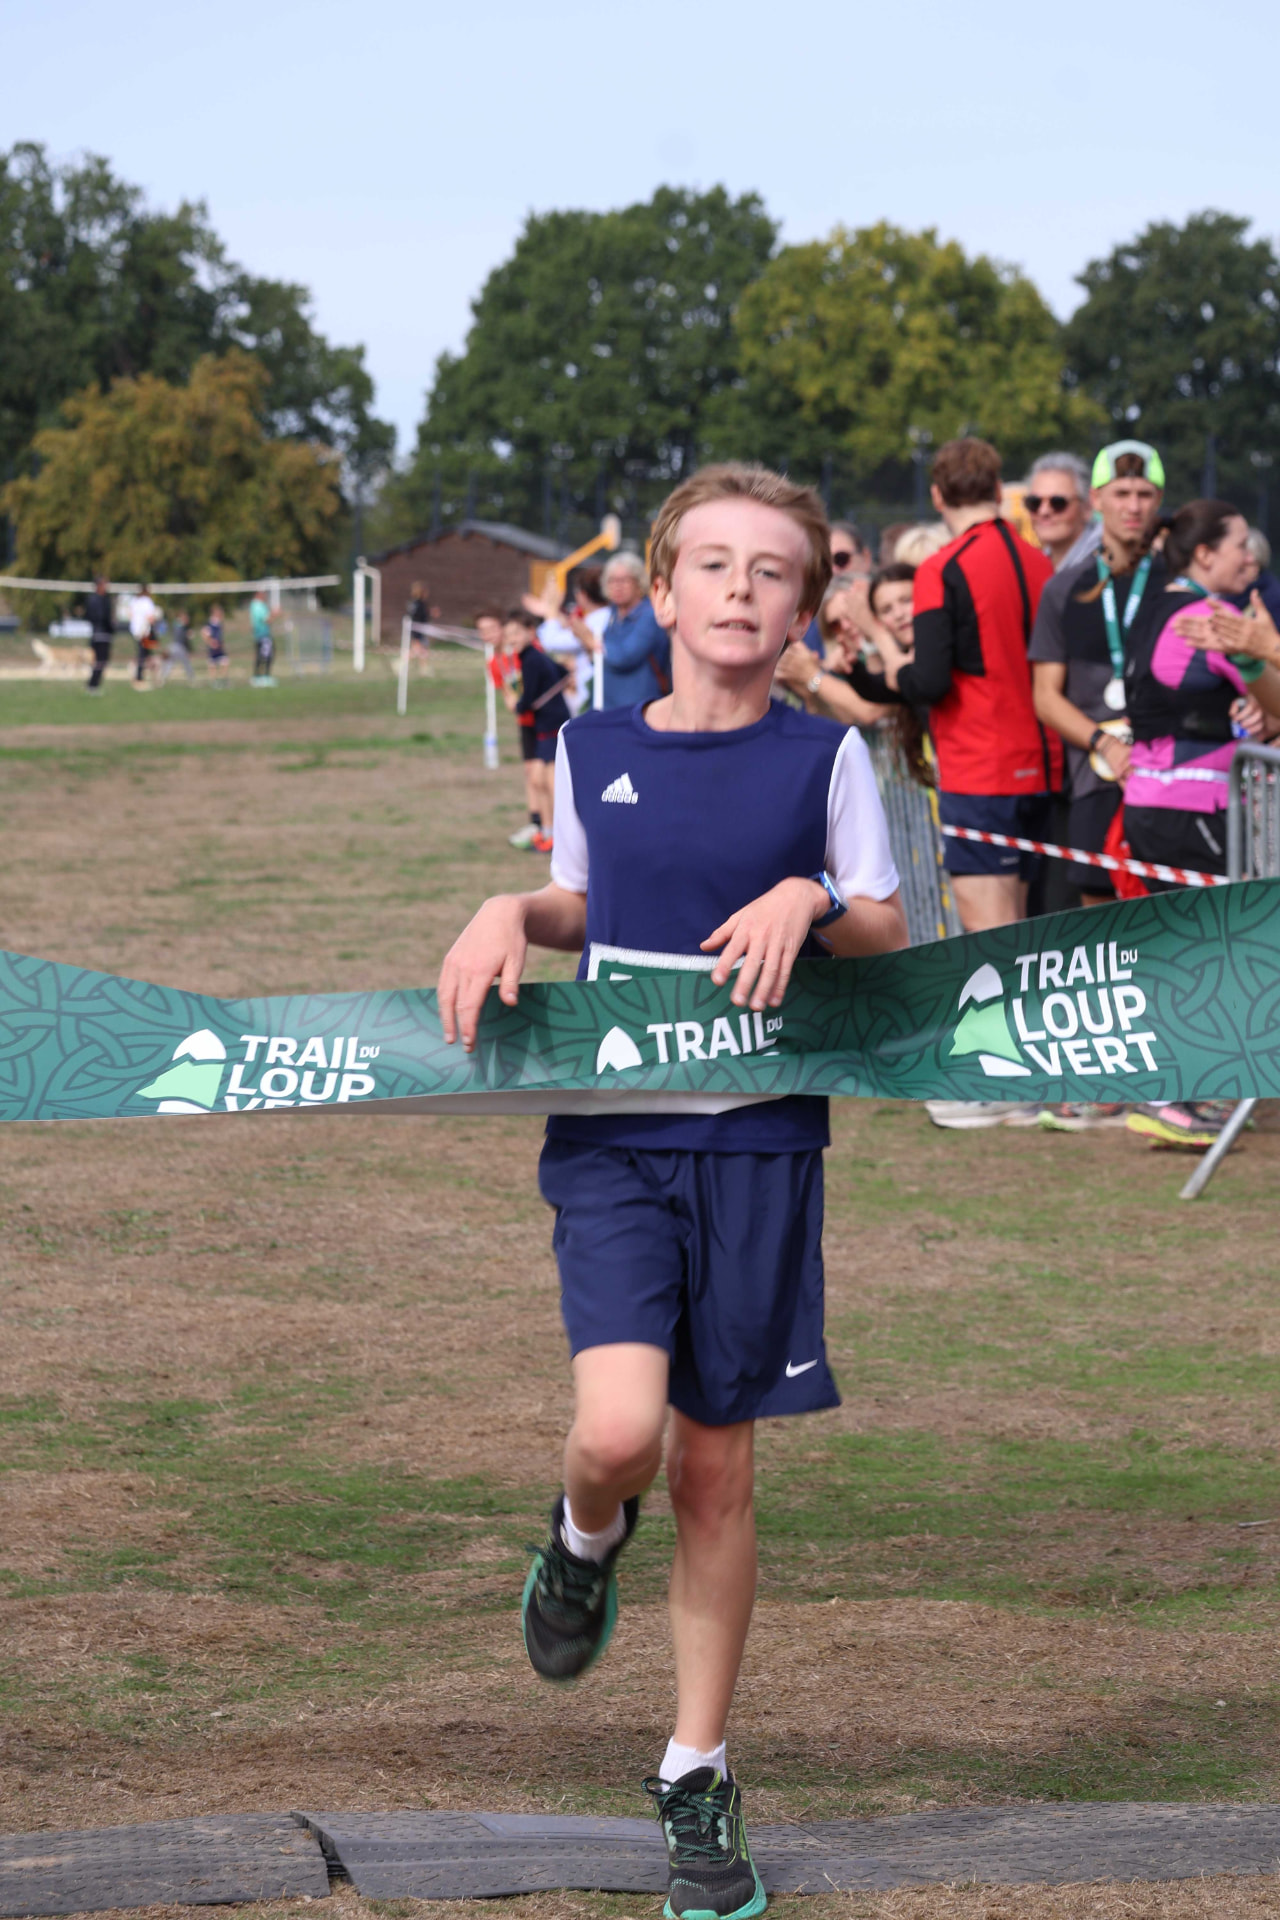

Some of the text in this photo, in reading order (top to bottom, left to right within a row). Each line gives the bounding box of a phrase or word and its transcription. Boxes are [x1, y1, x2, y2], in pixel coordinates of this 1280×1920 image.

[601, 787, 639, 805] adidas
[1014, 941, 1138, 992] TRAIL DU
[1012, 985, 1147, 1042] LOUP
[239, 1034, 381, 1070] TRAIL DU
[646, 1012, 783, 1063] TRAIL DU
[1023, 1031, 1159, 1076] VERT
[226, 1064, 376, 1103] LOUP
